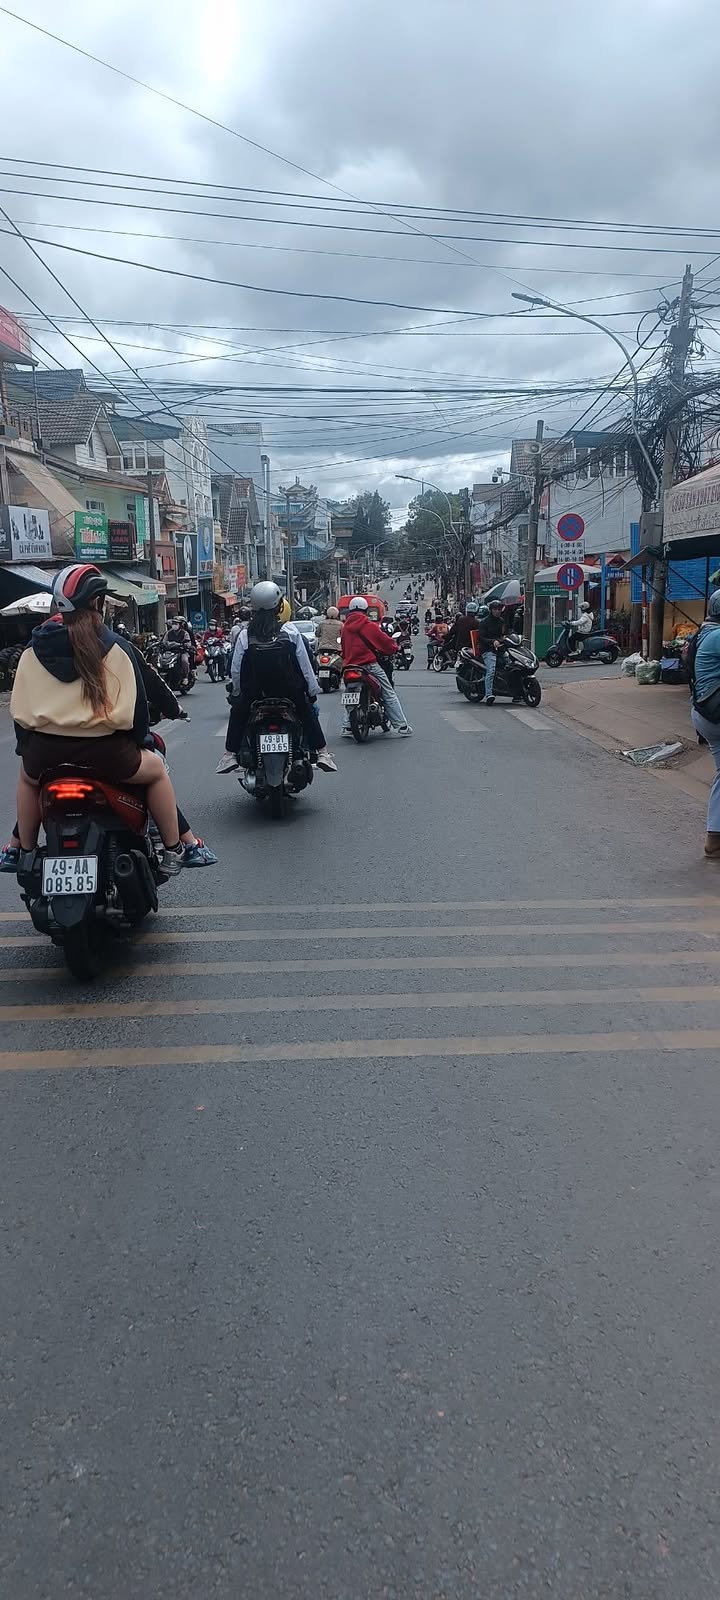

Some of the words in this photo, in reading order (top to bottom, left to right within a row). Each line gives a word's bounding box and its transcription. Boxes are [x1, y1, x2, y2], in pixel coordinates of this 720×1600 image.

[261, 742, 288, 752] 903.65
[51, 859, 89, 875] 49-AA
[45, 875, 94, 893] 085.85
